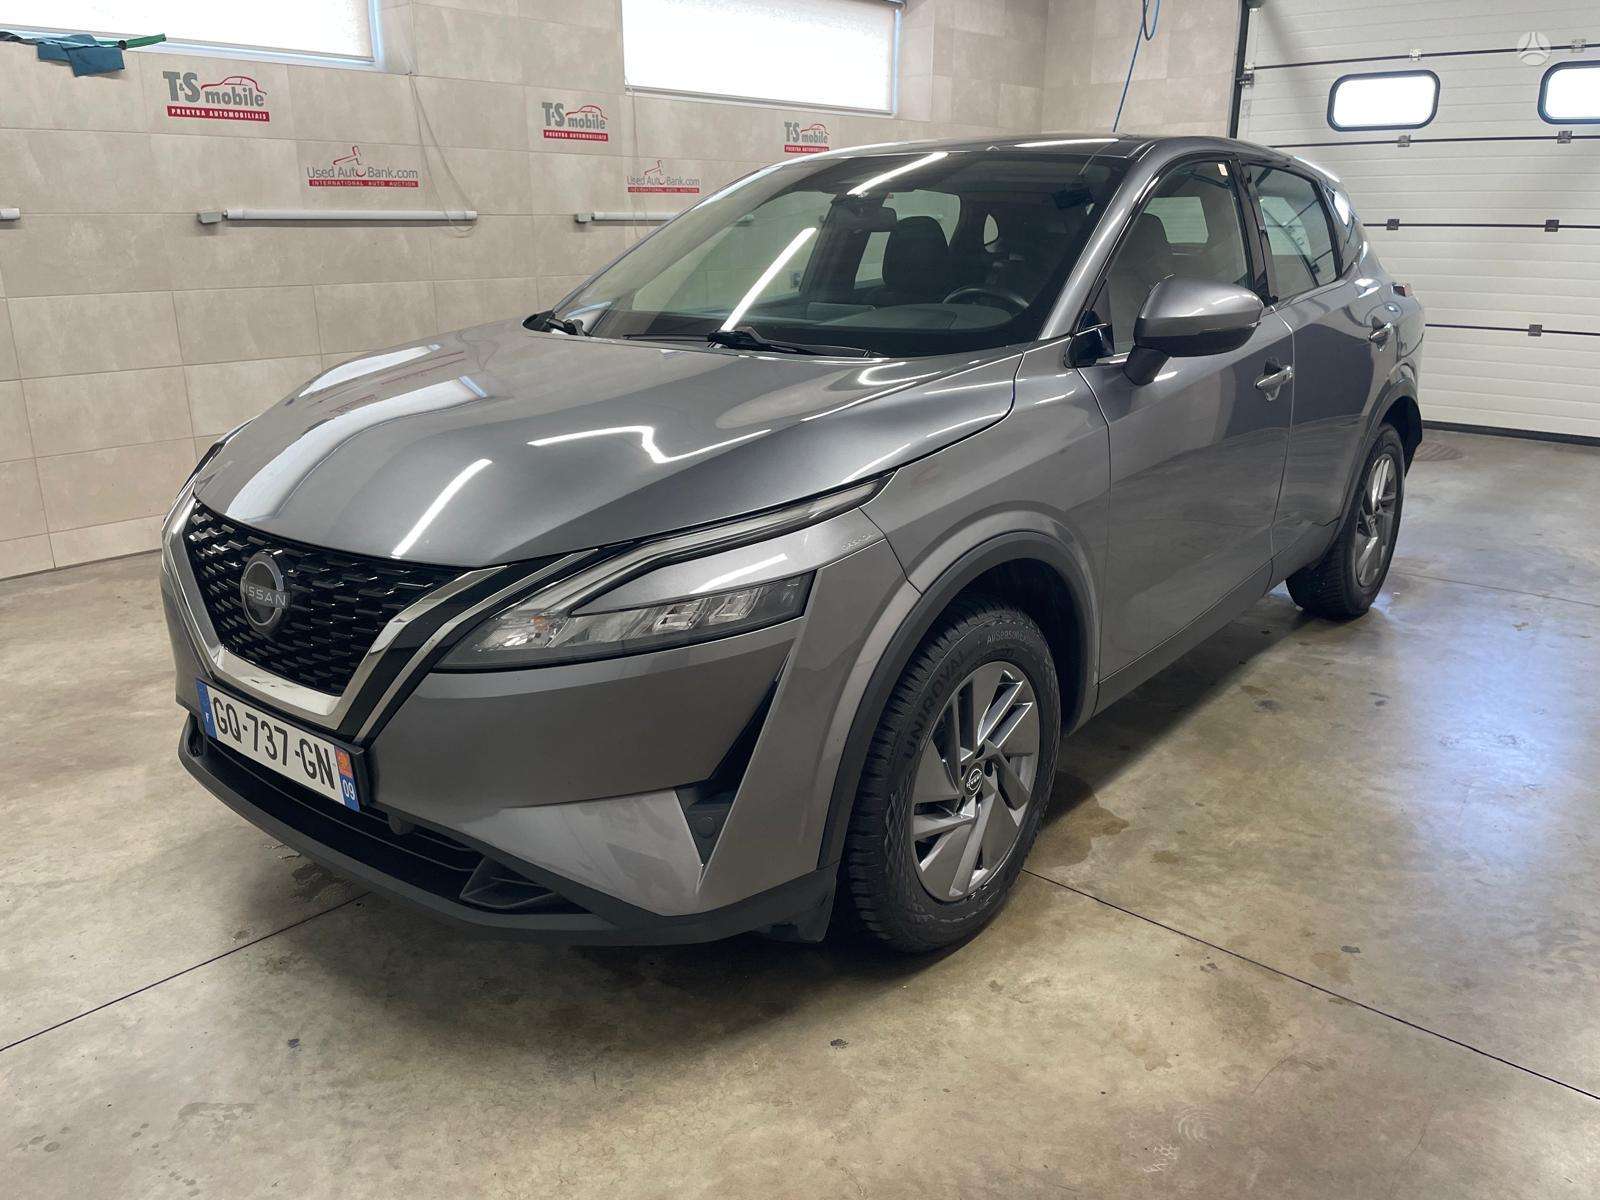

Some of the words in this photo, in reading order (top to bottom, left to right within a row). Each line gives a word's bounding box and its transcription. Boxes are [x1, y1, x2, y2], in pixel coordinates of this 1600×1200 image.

[204, 86, 264, 107] mobile
[171, 108, 206, 116] PREKYBA
[209, 110, 267, 120] AUTOMOBILIAIS
[568, 113, 606, 130] mobile
[801, 130, 828, 144] mobile
[306, 166, 335, 178] Used
[367, 166, 418, 179] Bank.com
[213, 696, 335, 790] GQ-737-GN
[342, 779, 356, 801] 09
